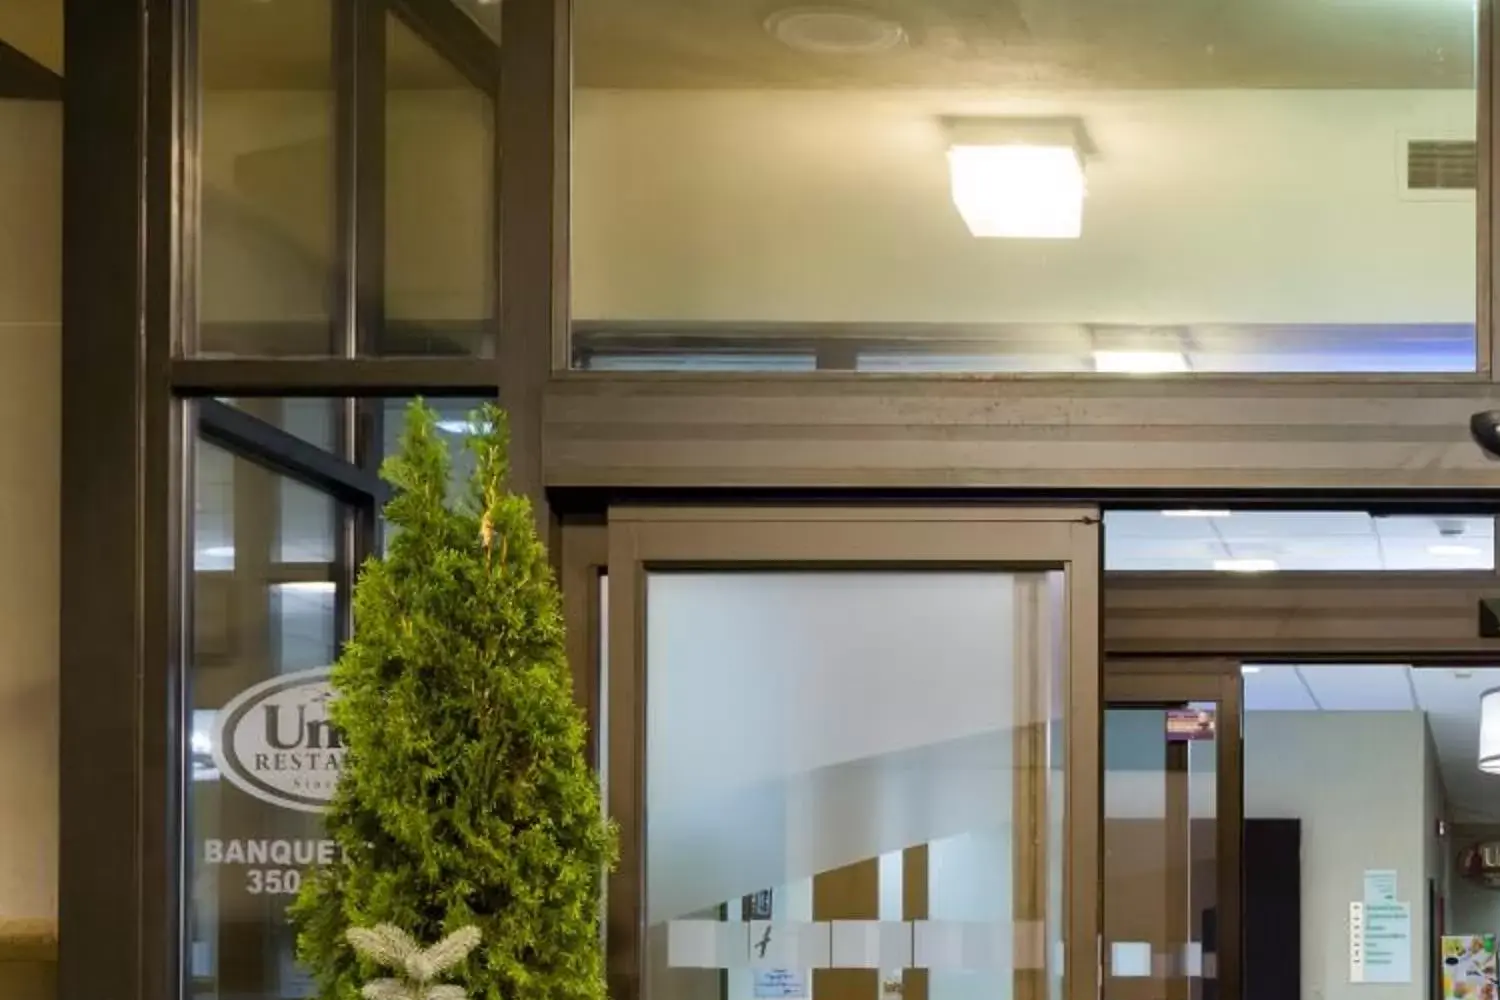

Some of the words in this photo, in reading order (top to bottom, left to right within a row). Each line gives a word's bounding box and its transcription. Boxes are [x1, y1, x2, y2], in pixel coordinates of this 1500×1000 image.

[265, 705, 346, 750] Un
[256, 753, 339, 770] RESTA
[294, 779, 331, 791] Sinc
[246, 869, 300, 894] 350
